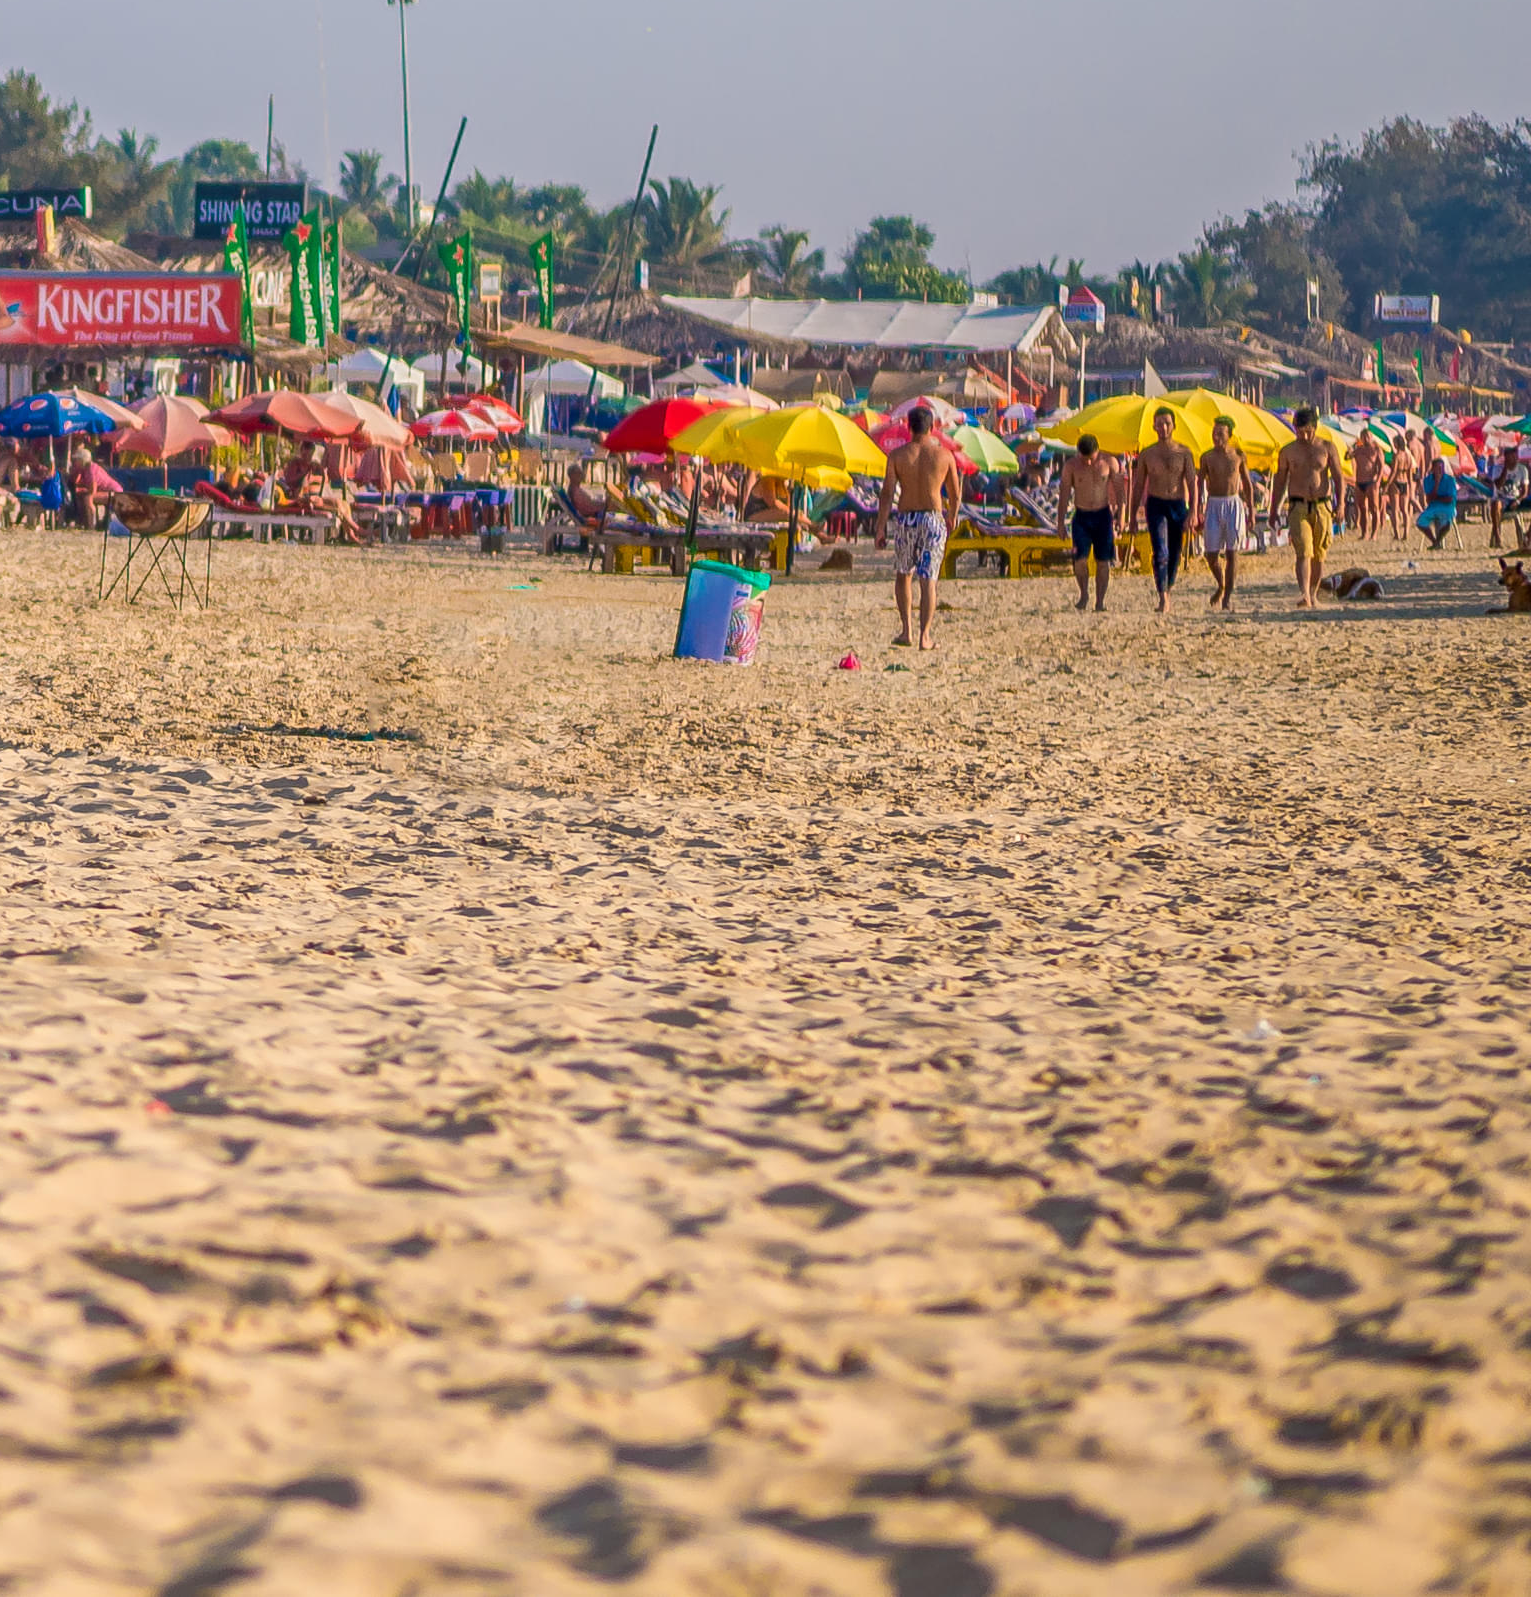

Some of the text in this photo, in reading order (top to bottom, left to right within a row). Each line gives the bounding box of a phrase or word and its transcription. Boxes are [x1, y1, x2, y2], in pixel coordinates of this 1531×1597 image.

[199, 200, 301, 224] SHINNG STAR
[38, 284, 230, 334] KINGFISHER
[74, 330, 92, 341] The
[95, 330, 118, 342] King
